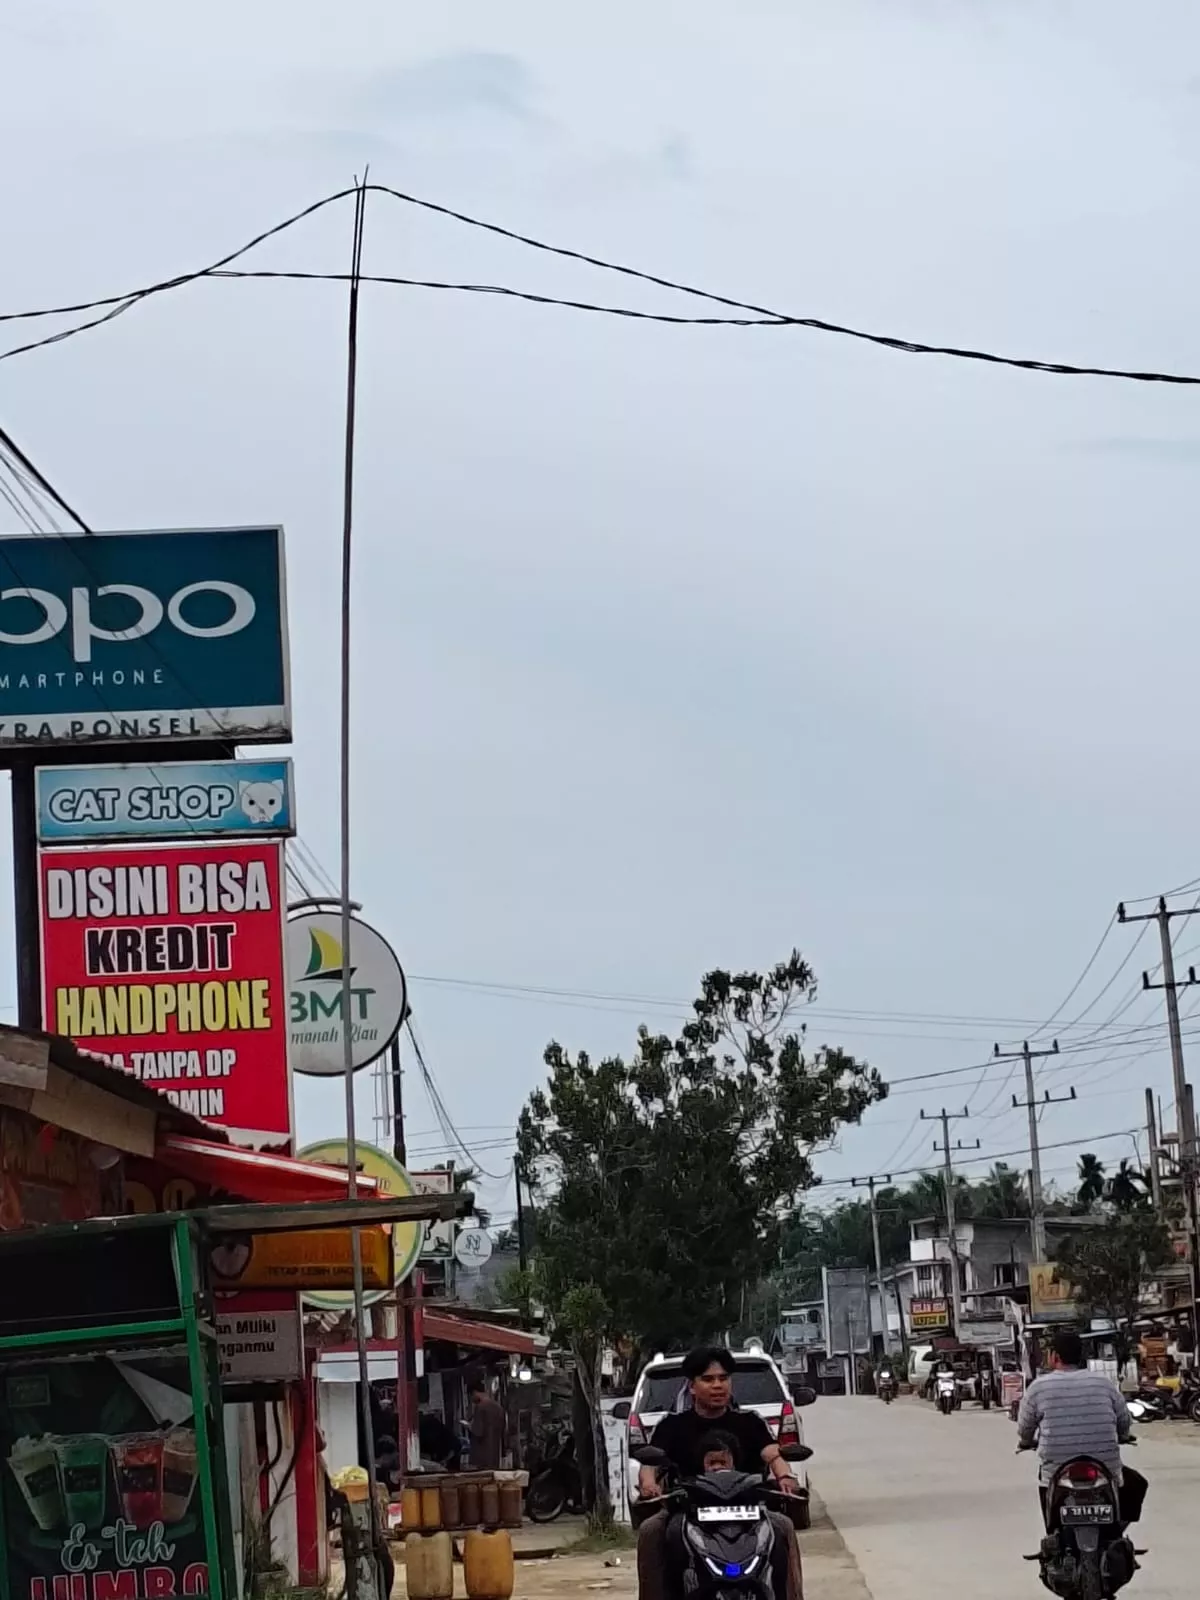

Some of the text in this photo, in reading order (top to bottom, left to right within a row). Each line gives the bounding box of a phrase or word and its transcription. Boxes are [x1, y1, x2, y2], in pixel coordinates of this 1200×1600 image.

[0, 716, 201, 743] RA PONSEL
[49, 785, 234, 822] CAT SHOP
[47, 860, 272, 919] DISINI BISA
[84, 921, 236, 976] KREDIT
[56, 979, 271, 1036] HANDPHONE
[291, 988, 376, 1023] BMT
[131, 1050, 201, 1080] TANPA
[205, 1048, 237, 1077] DP
[158, 1088, 224, 1116] DMIN
[60, 1522, 102, 1572] Es
